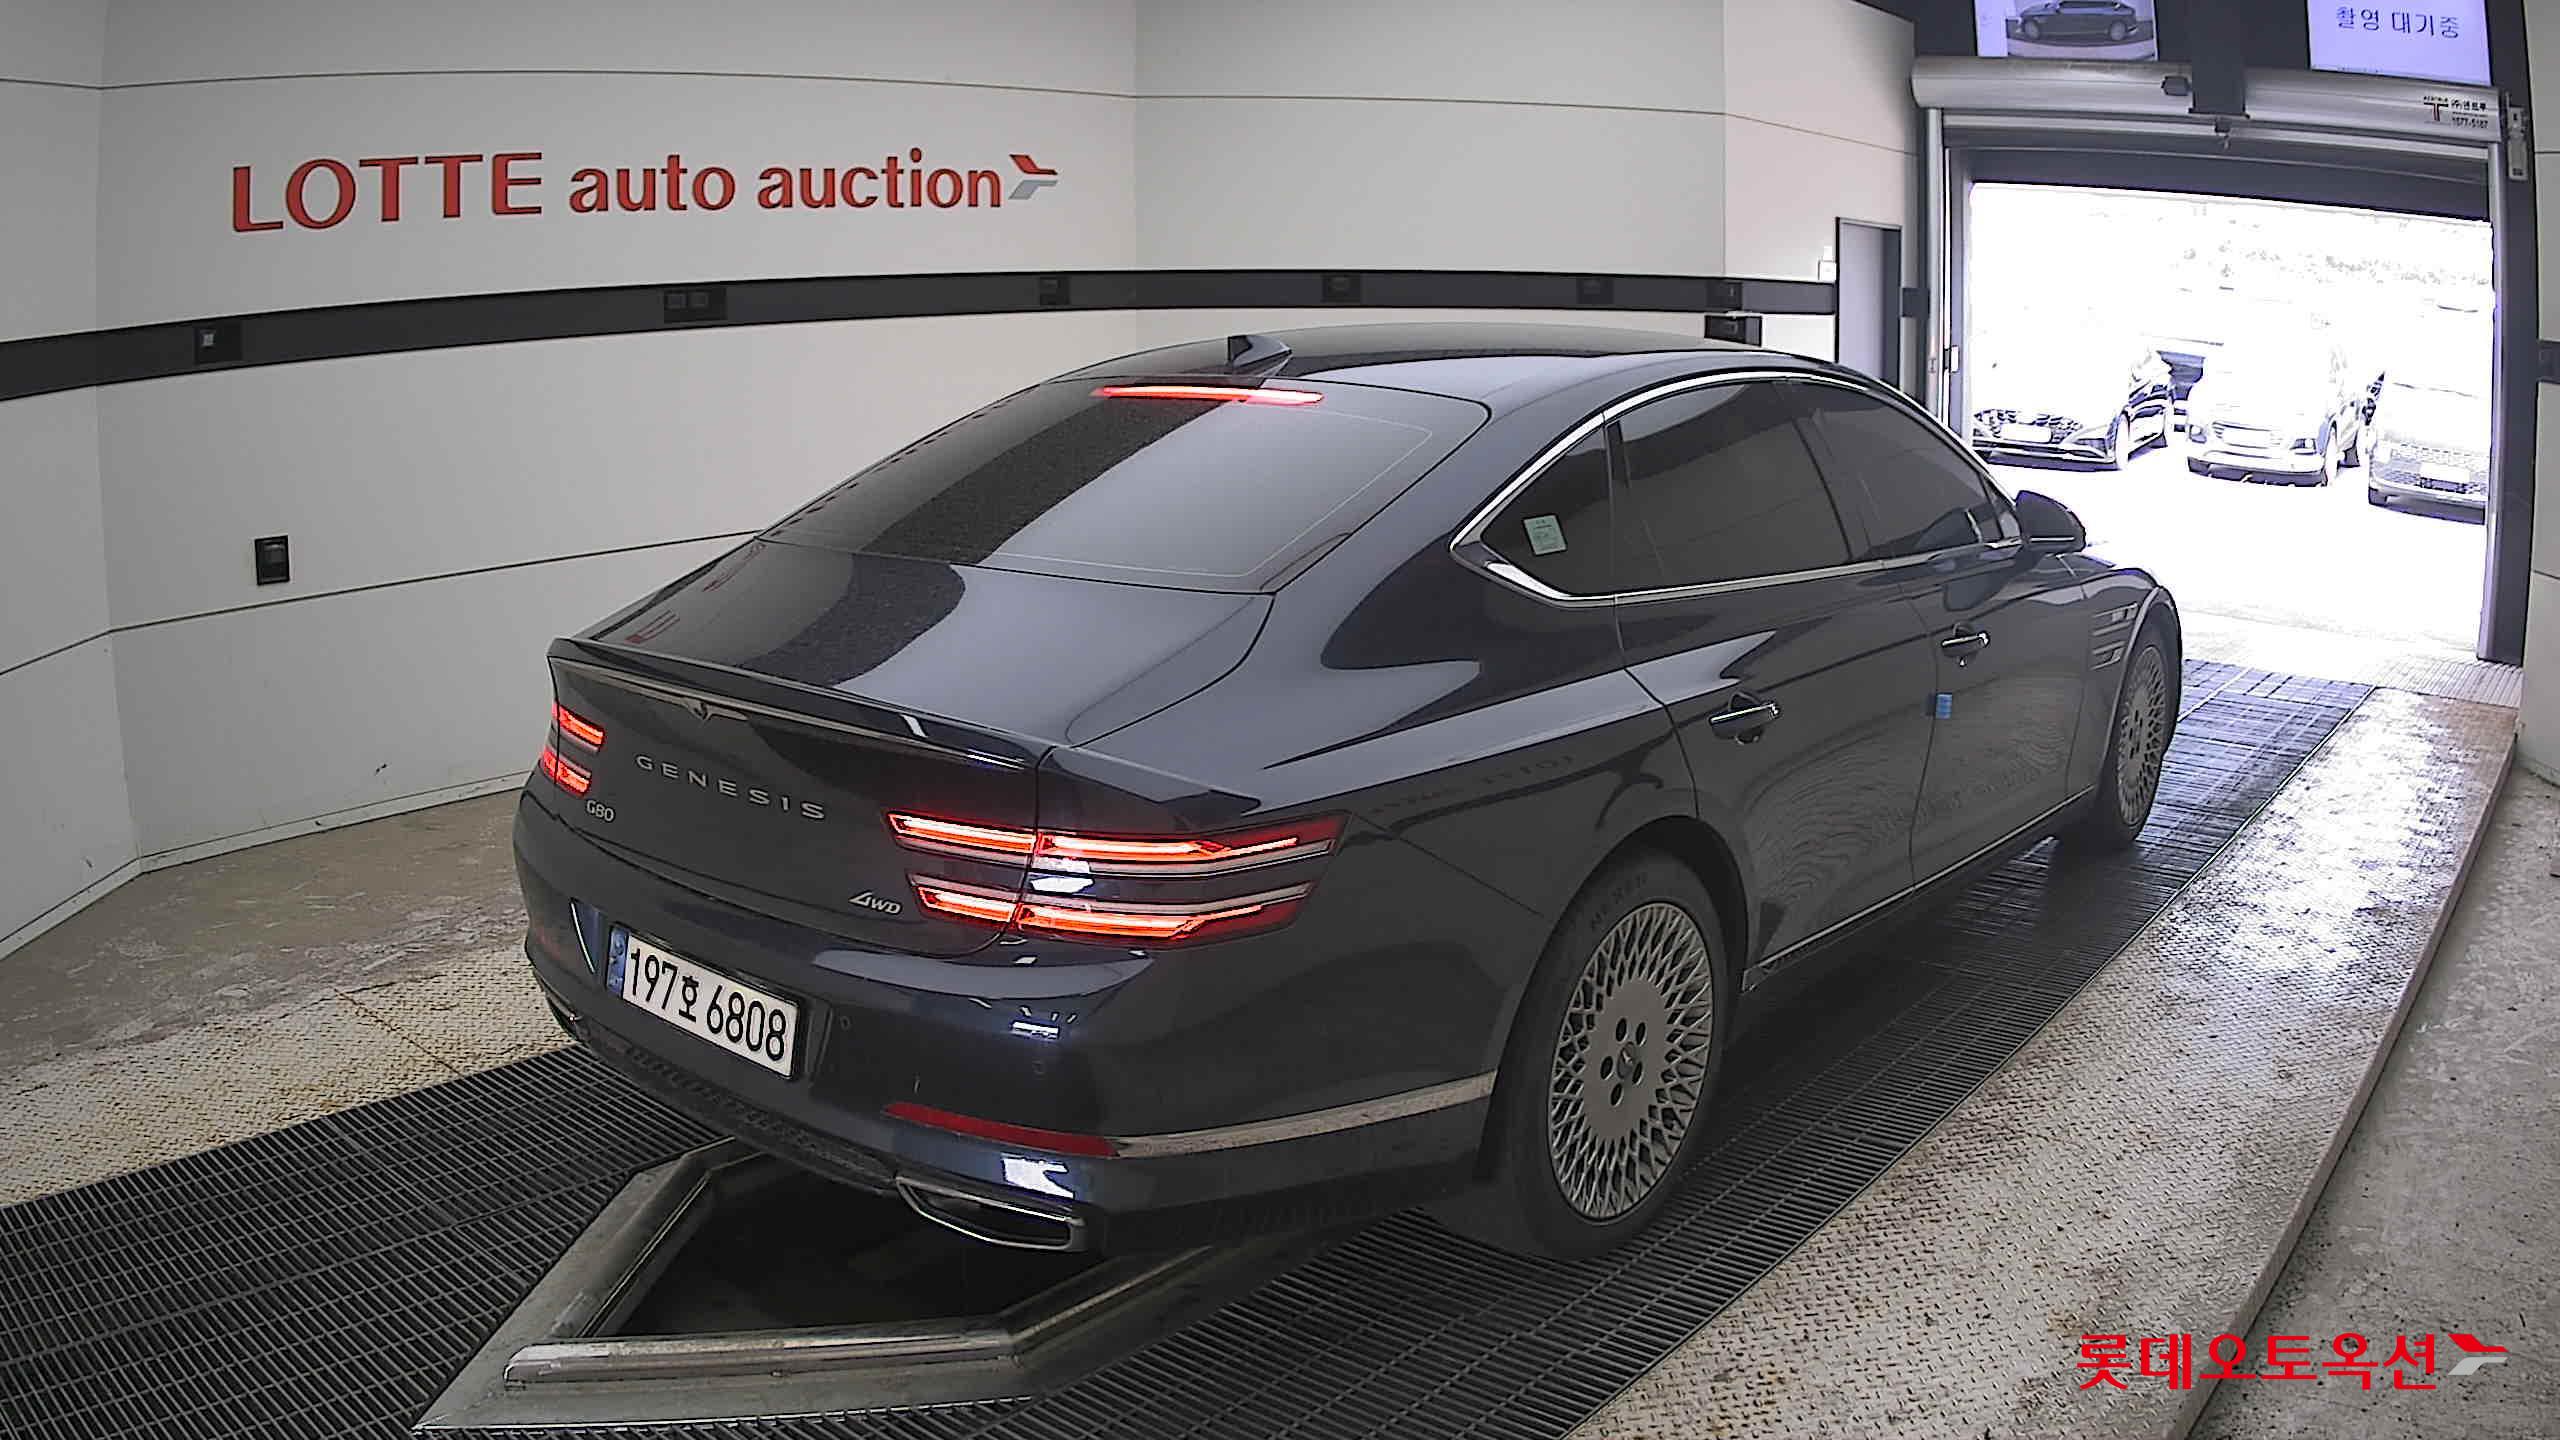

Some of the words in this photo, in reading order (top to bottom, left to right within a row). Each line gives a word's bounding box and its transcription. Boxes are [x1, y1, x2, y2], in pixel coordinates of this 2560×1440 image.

[2391, 12, 2459, 39] 대기중
[232, 152, 542, 233] LOTTE
[568, 153, 736, 213] auto
[757, 147, 1003, 210] auction
[635, 754, 826, 820] GENESIS
[585, 798, 617, 824] G80
[849, 890, 902, 915] 4WD
[706, 984, 787, 1062] 6808
